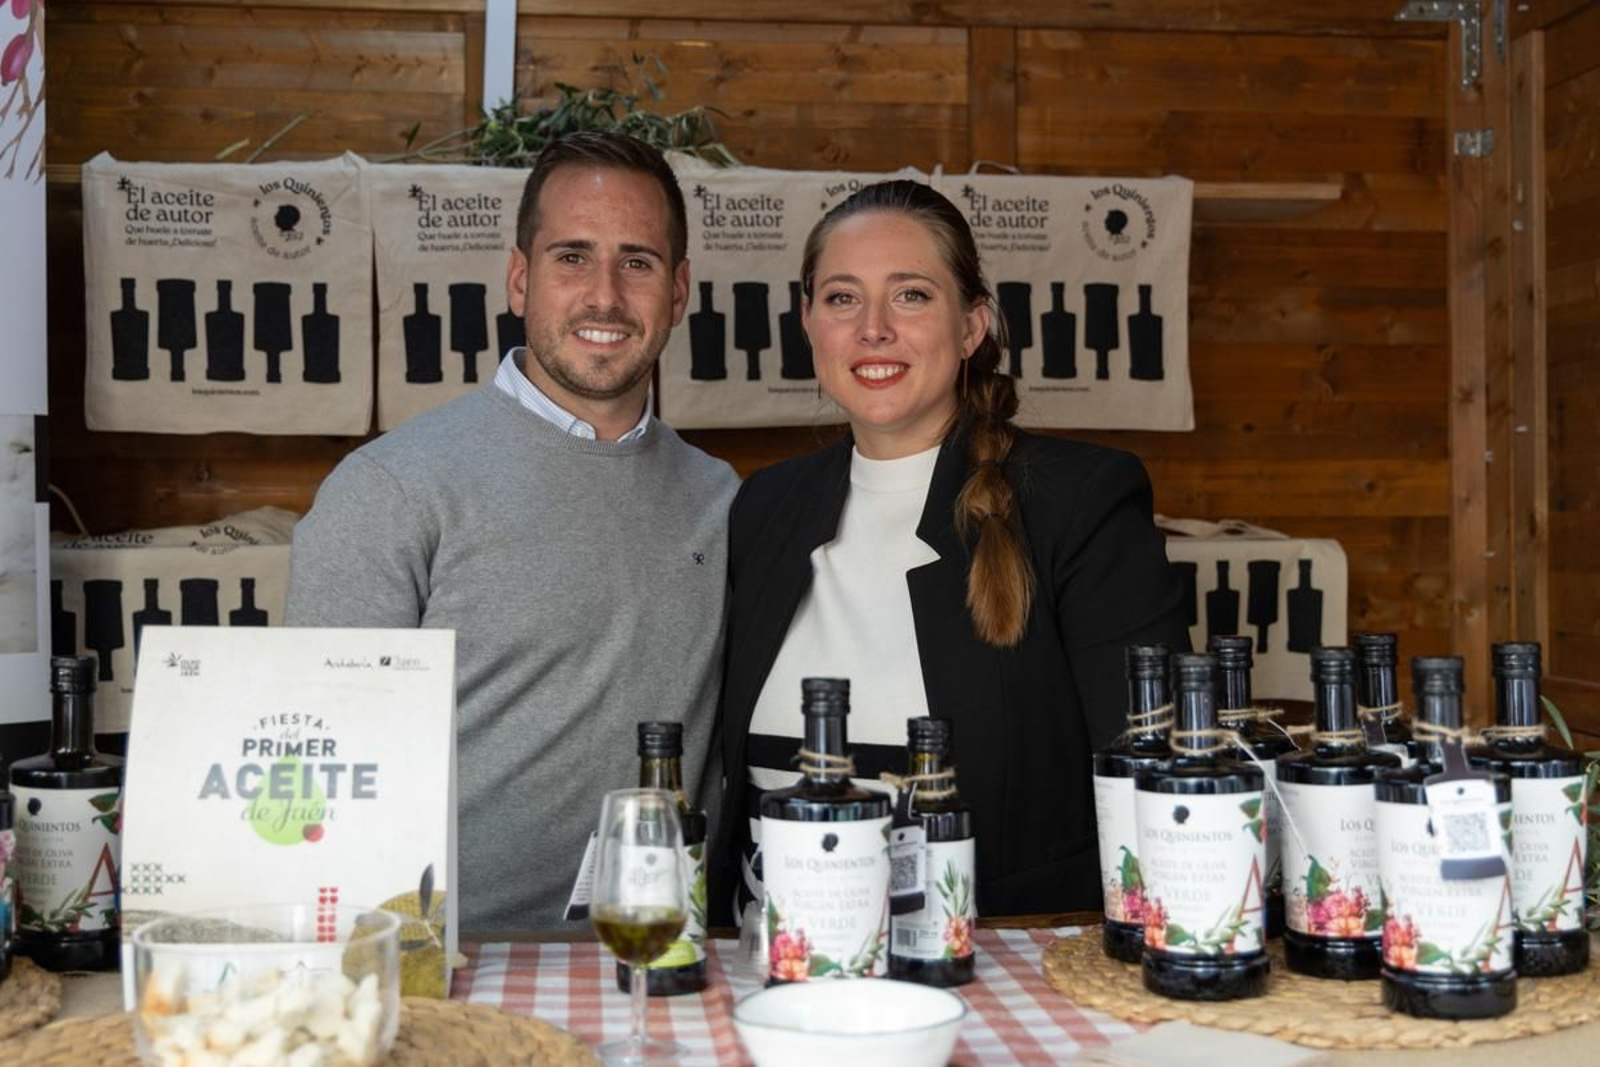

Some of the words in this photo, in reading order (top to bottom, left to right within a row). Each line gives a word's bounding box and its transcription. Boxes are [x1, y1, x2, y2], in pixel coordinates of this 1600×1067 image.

[127, 186, 146, 204] El
[151, 189, 214, 206] aceite
[826, 183, 846, 197] los
[259, 181, 281, 195] los
[283, 177, 331, 235] Quinientos
[418, 193, 437, 211] El
[441, 193, 502, 211] aceite
[703, 193, 720, 211] El
[726, 193, 784, 211] aceite
[970, 193, 987, 212] El
[991, 195, 1050, 213] aceite
[1090, 186, 1110, 200] los
[1112, 184, 1156, 239] Quinientos
[126, 203, 151, 221] de
[156, 208, 214, 224] autor
[418, 208, 442, 228] de
[447, 213, 502, 228] autor
[703, 207, 726, 228] de
[731, 213, 783, 228] autor
[970, 207, 993, 228] de
[996, 214, 1048, 229] autor
[200, 526, 220, 538] los
[258, 712, 323, 730] FIESTA
[241, 737, 338, 758] PRIMER
[198, 762, 379, 801] ACEITE
[240, 799, 271, 823] de
[271, 799, 337, 833] Jaén
[1340, 818, 1361, 832] LOS
[1161, 829, 1233, 845] QUINIENTOS
